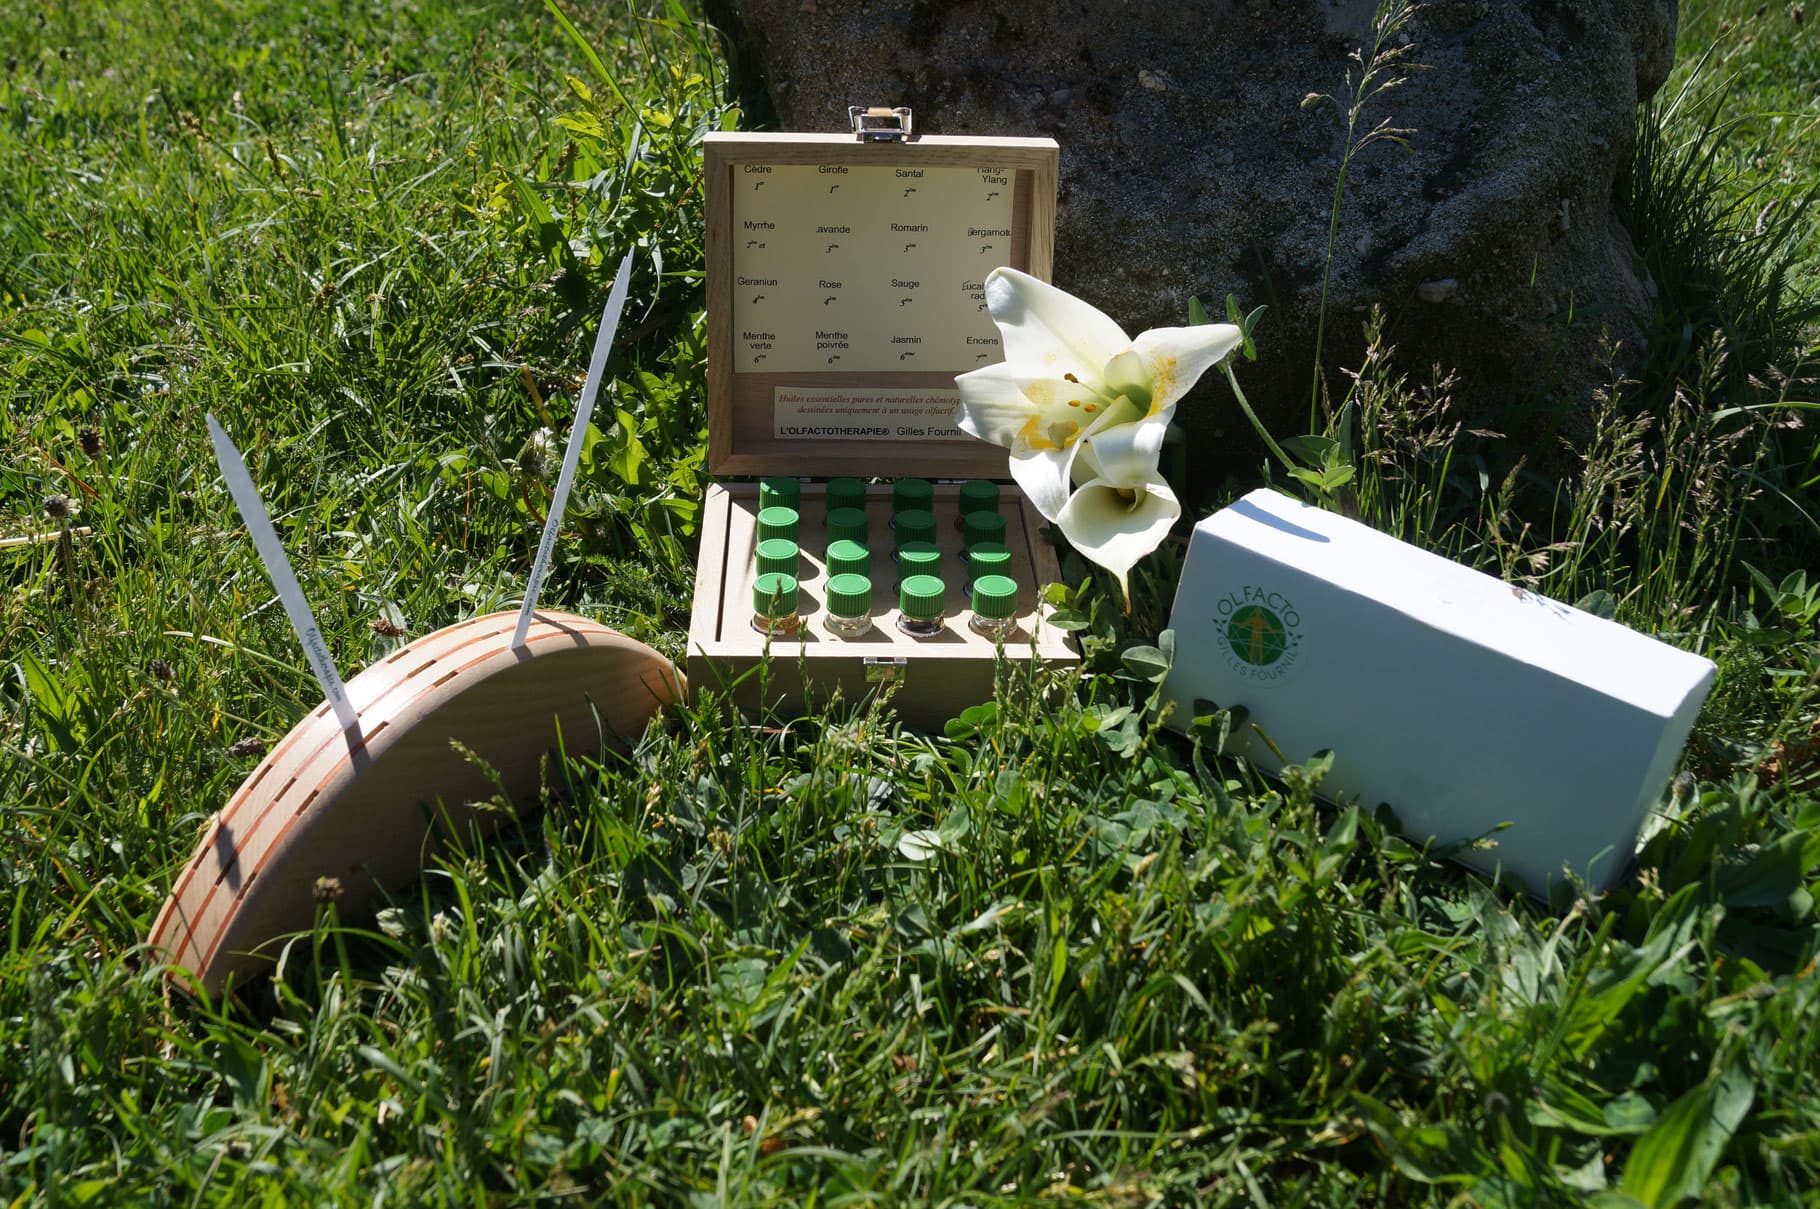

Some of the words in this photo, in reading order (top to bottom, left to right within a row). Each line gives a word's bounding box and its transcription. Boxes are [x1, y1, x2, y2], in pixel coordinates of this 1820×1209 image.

[895, 169, 924, 178] Santal
[982, 175, 1008, 186] Ylang
[744, 221, 775, 232] Myrrhe
[816, 225, 851, 234] avande
[890, 223, 929, 233] Romarin
[818, 280, 842, 289] Rose
[891, 279, 920, 290] Sauge
[743, 332, 776, 341] Menthe
[816, 331, 848, 340] Menthe
[890, 336, 922, 345] Jasmin
[750, 342, 772, 350] verte
[816, 340, 849, 351] poivrée
[966, 336, 999, 346] Encens
[779, 394, 805, 404] Huiles
[806, 394, 850, 404] essentielles
[851, 396, 874, 406] pures
[875, 395, 884, 404] et
[885, 395, 923, 404] naturelles
[797, 405, 833, 414] destinées
[835, 406, 880, 416] uniquement
[882, 405, 888, 414] à
[901, 407, 923, 416] usage
[924, 405, 954, 416] olfactif
[896, 426, 925, 437] Gilles
[927, 426, 962, 437] Fournil
[1217, 585, 1300, 628] OLFACTO
[1217, 636, 1248, 677] GILLES
[1250, 648, 1299, 681] FOURNIL
